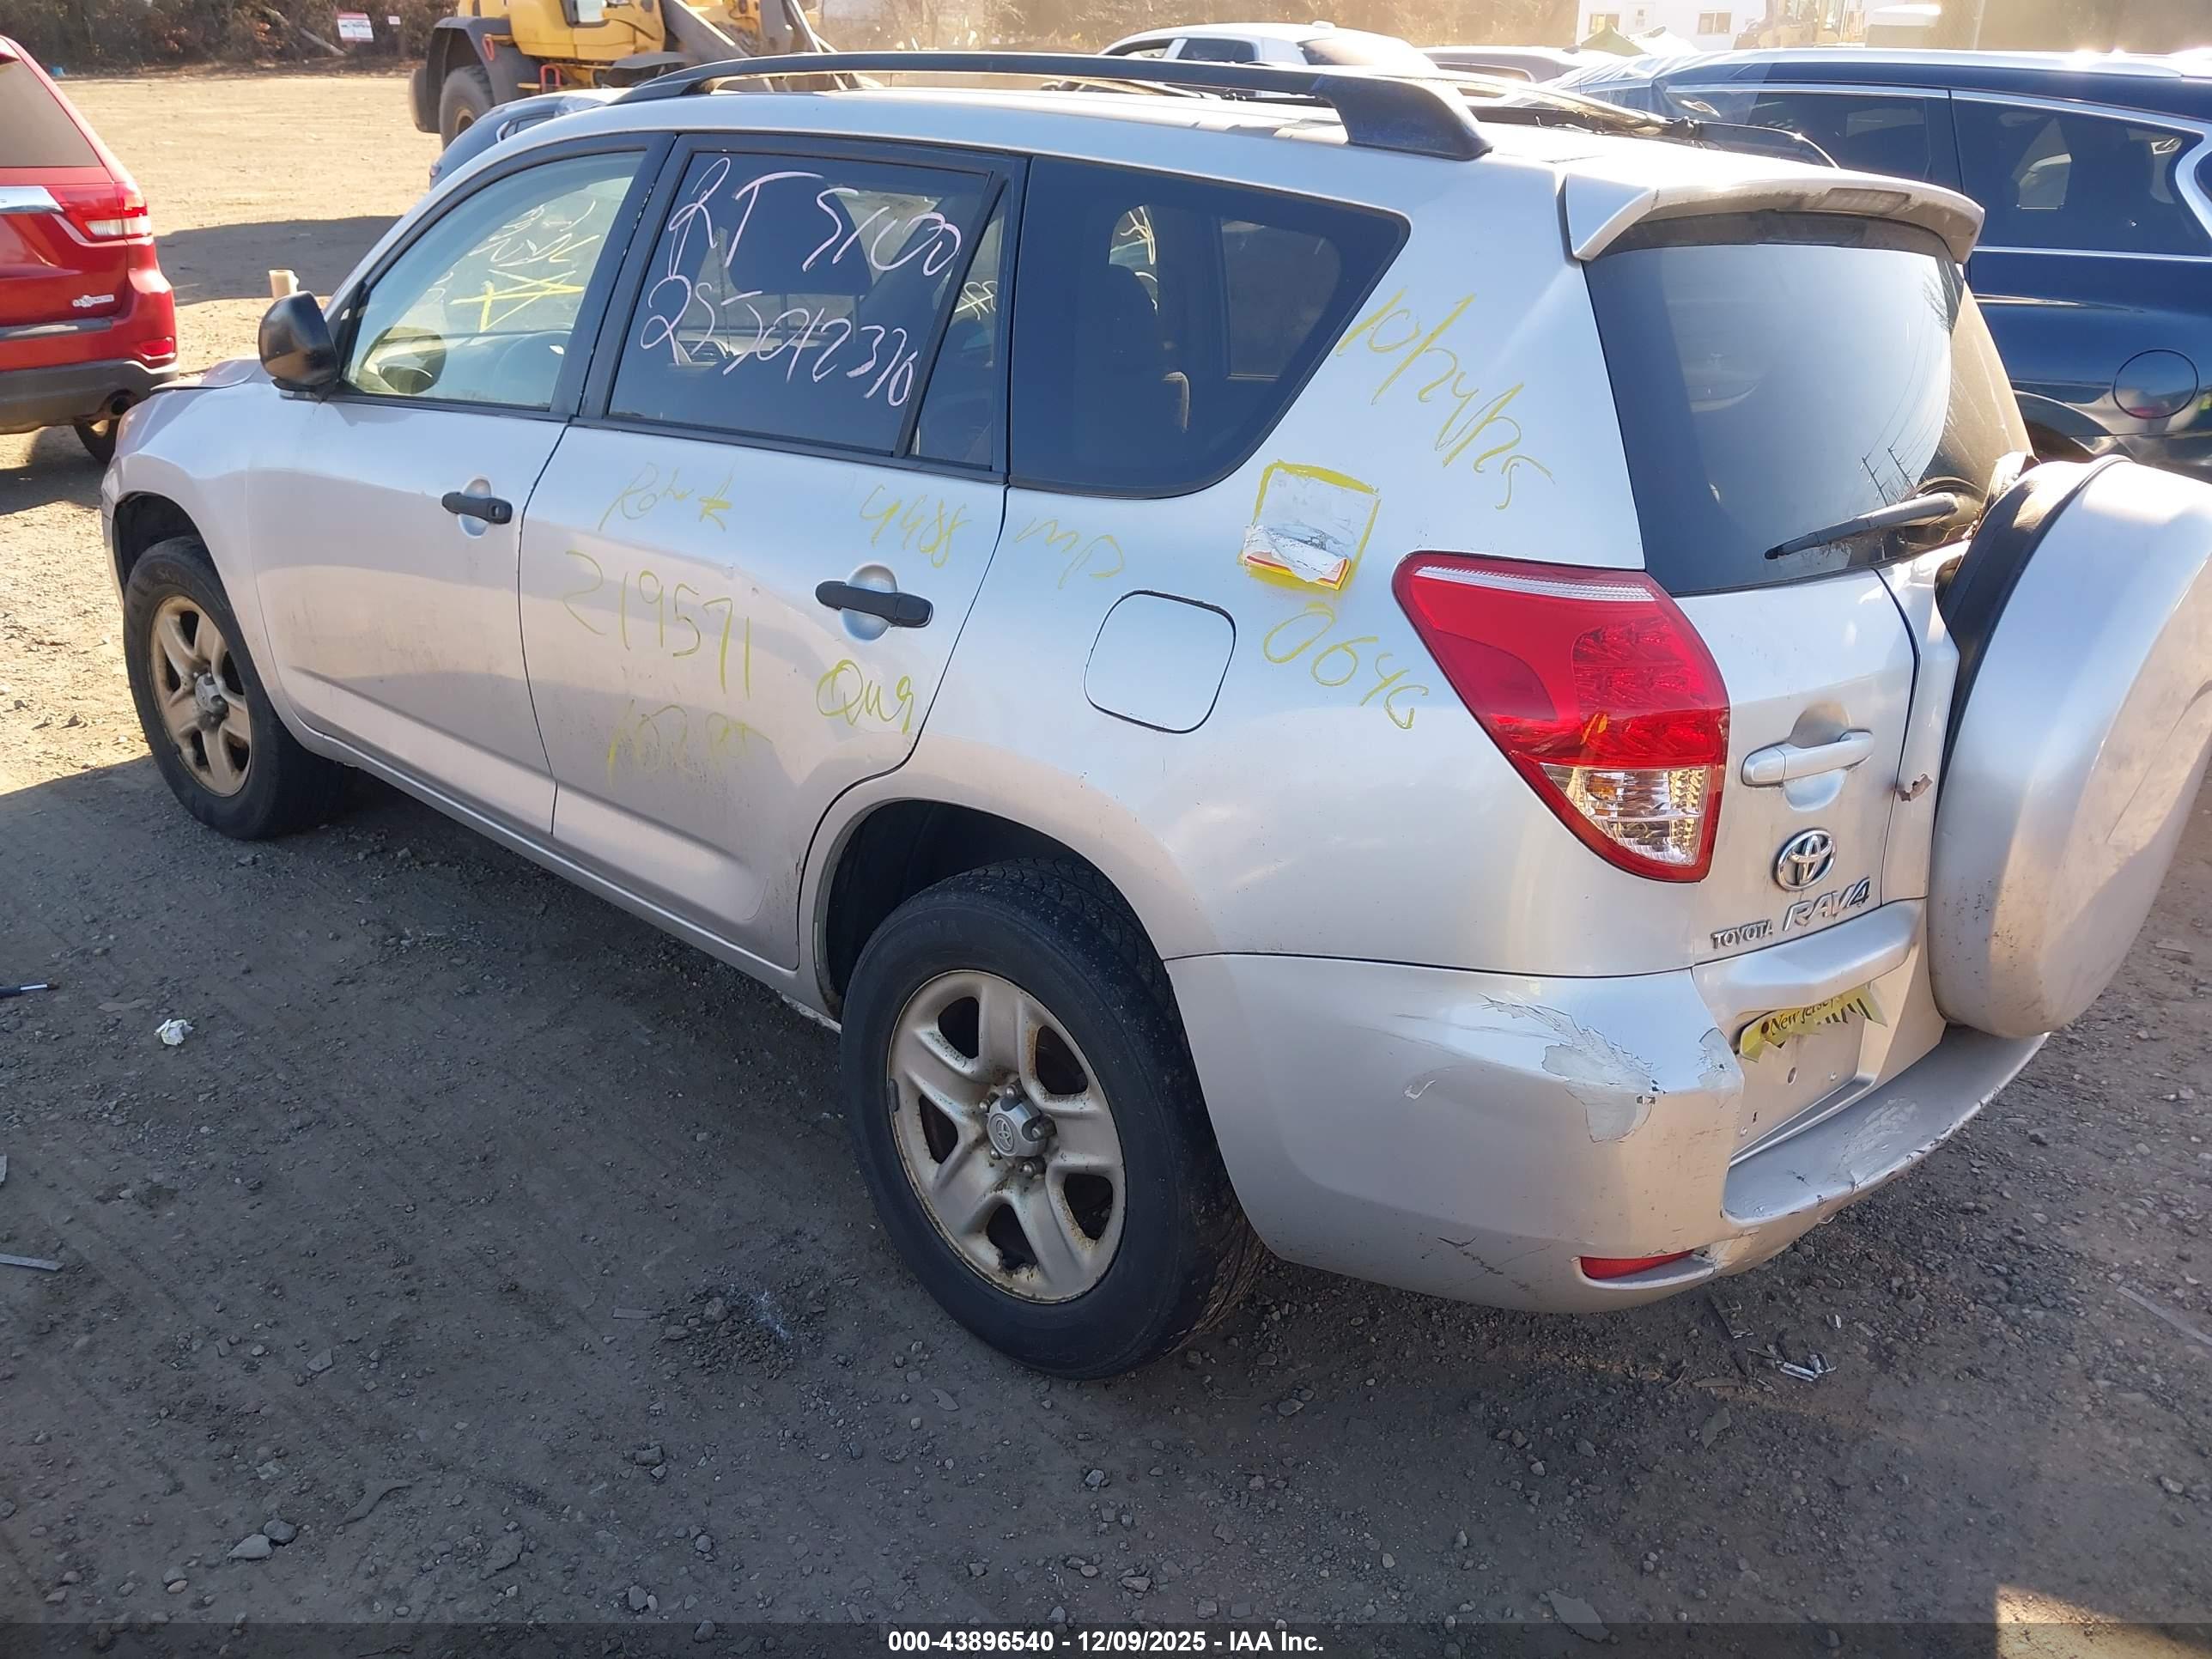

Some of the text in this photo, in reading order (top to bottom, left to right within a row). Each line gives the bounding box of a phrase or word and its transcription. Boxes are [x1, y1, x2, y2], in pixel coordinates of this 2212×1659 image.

[563, 550, 752, 701] 219571
[1711, 878, 1871, 949] TOYOTA RAV4
